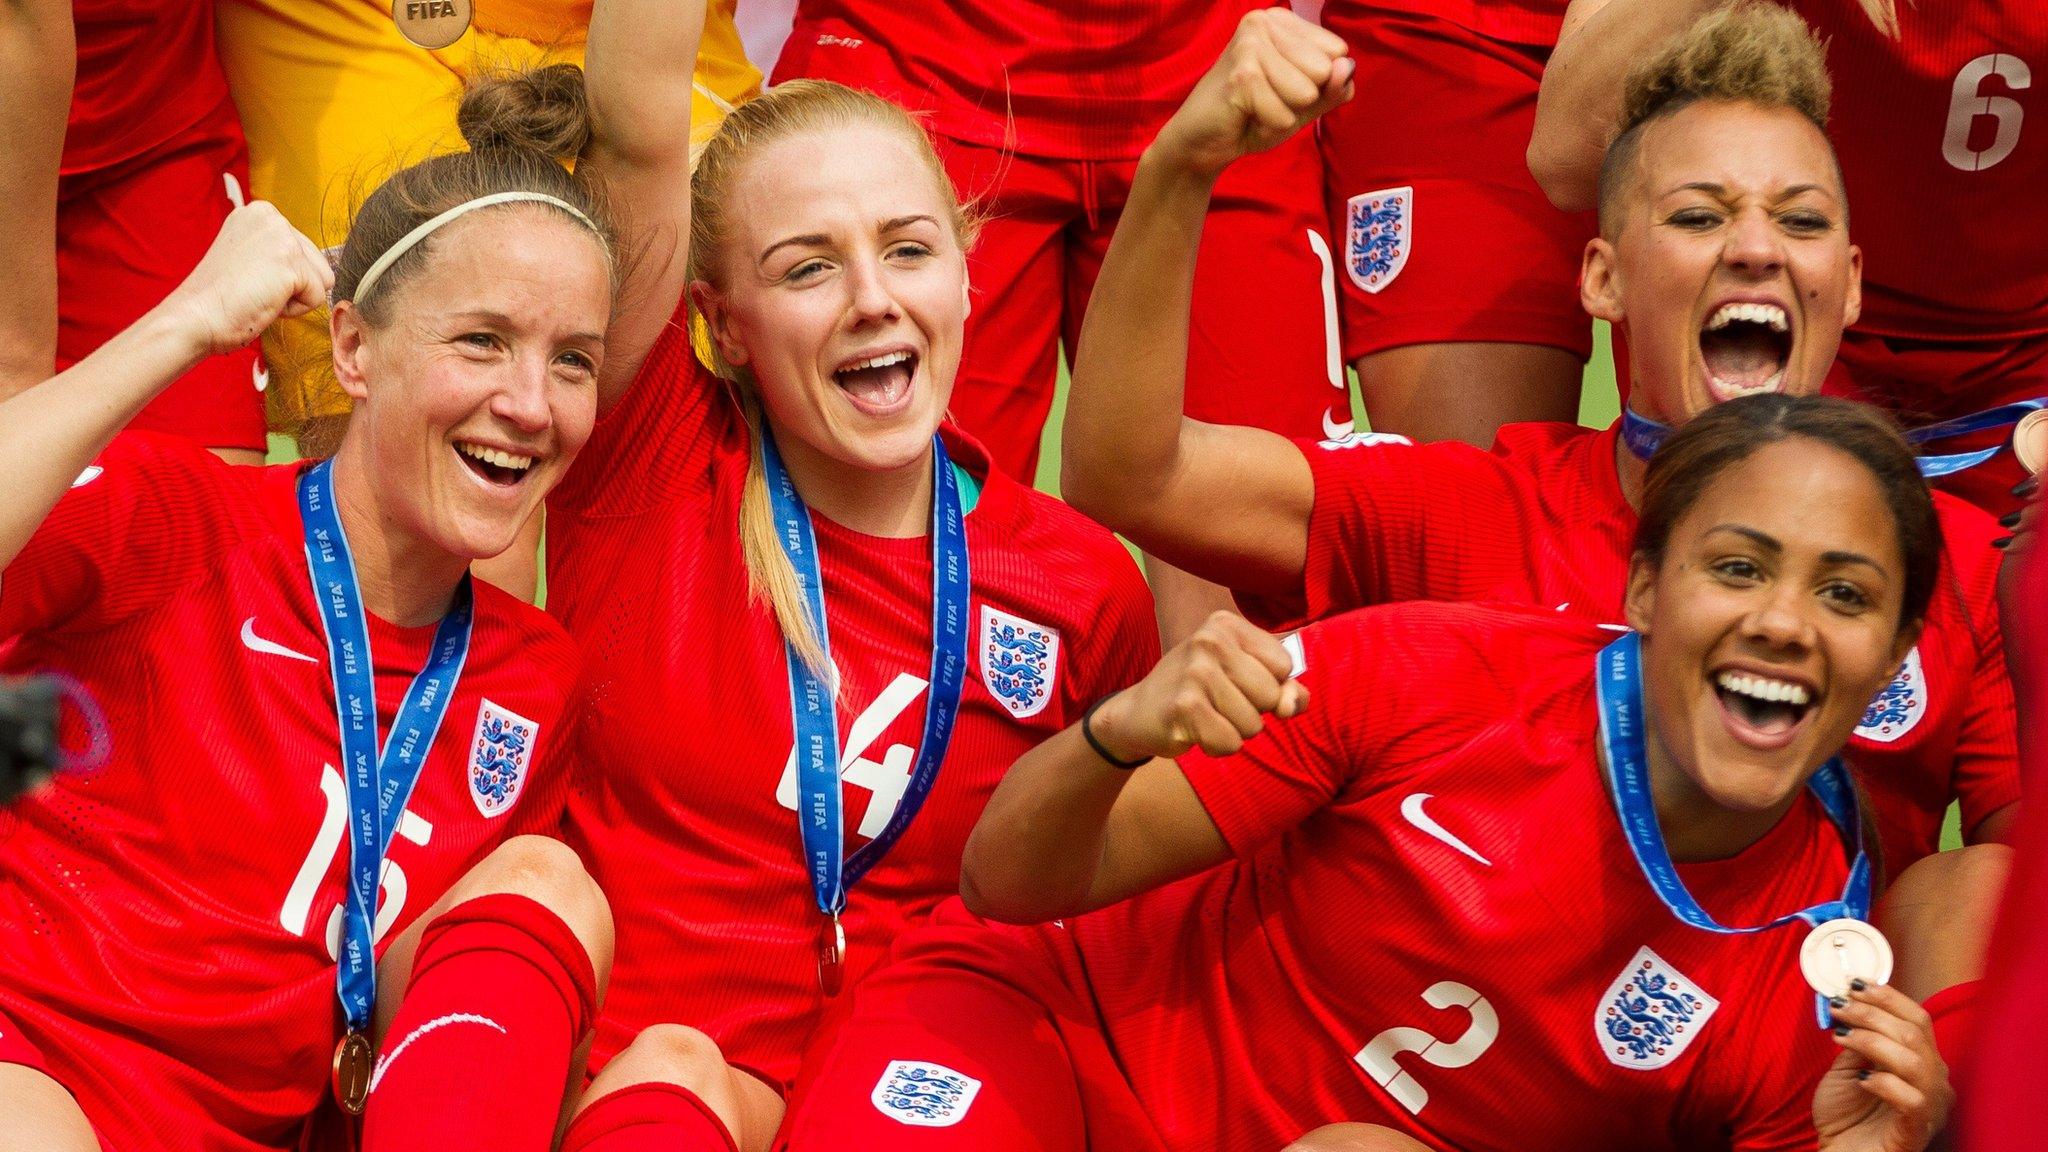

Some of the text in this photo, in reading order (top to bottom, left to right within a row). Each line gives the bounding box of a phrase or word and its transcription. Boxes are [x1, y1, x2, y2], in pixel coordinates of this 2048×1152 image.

[407, 0, 457, 20] FIFA
[1942, 53, 2031, 171] 6
[945, 456, 954, 490] FIFA
[309, 484, 321, 511] FIFA
[787, 519, 804, 556] FIFA
[947, 502, 957, 537] FIFA
[314, 528, 337, 563] FIFA
[948, 550, 959, 585] FIFA
[329, 581, 350, 619] FIFA
[946, 598, 958, 636] FIFA
[341, 638, 357, 675] FIFA
[943, 650, 957, 688] FIFA
[1612, 650, 1627, 681] FIFA
[350, 694, 364, 731] FIFA
[419, 678, 441, 713] FIFA
[806, 678, 822, 716] FIFA
[935, 701, 949, 740] FIFA
[1616, 701, 1633, 738] FIFA
[399, 728, 420, 765] FIFA
[810, 734, 826, 774] FIFA
[355, 750, 368, 789] FIFA
[916, 755, 934, 794] FIFA
[1626, 757, 1639, 794] FIFA
[381, 778, 400, 817] FIFA
[813, 792, 827, 831] FIFA
[361, 808, 374, 848] FIFA
[361, 866, 373, 905] FIFA
[816, 850, 829, 889] FIFA
[346, 937, 363, 975] FIFA
[1354, 981, 1500, 1116] 2
